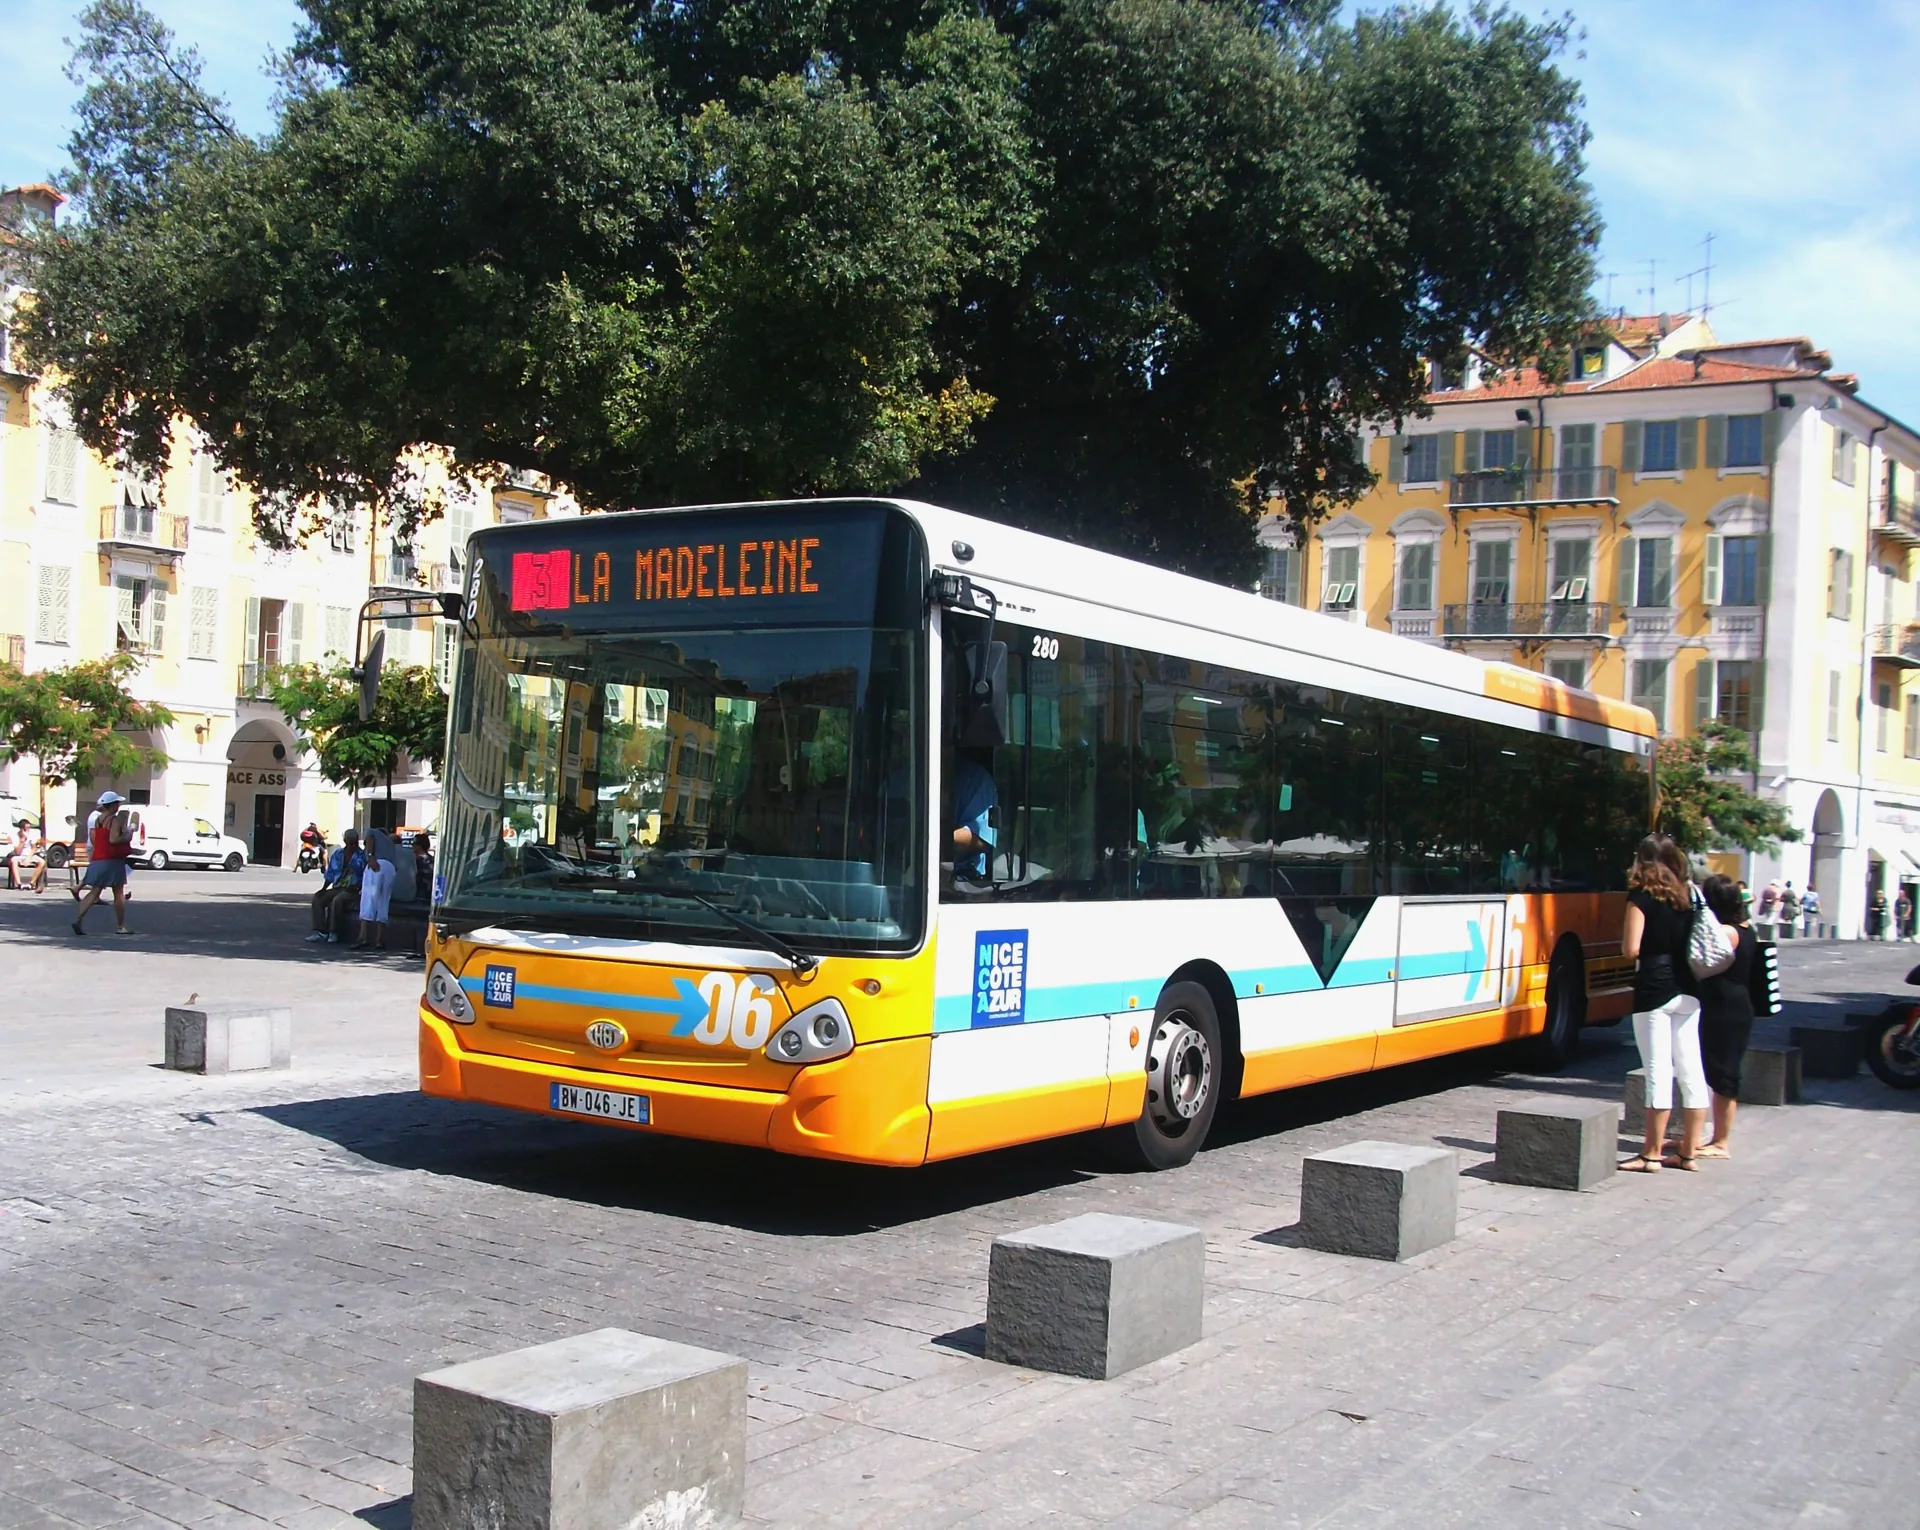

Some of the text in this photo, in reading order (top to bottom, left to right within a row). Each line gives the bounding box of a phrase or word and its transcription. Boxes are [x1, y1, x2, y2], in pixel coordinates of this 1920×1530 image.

[574, 552, 611, 603] LA
[635, 538, 820, 601] MADELEINE
[467, 557, 484, 620] 280
[1031, 634, 1059, 661] 280
[227, 771, 286, 786] ACE ASS
[979, 942, 1024, 967] NICE
[487, 970, 513, 983] NICE
[693, 970, 776, 1050] 06
[561, 1087, 636, 1118] BW-046-JE
